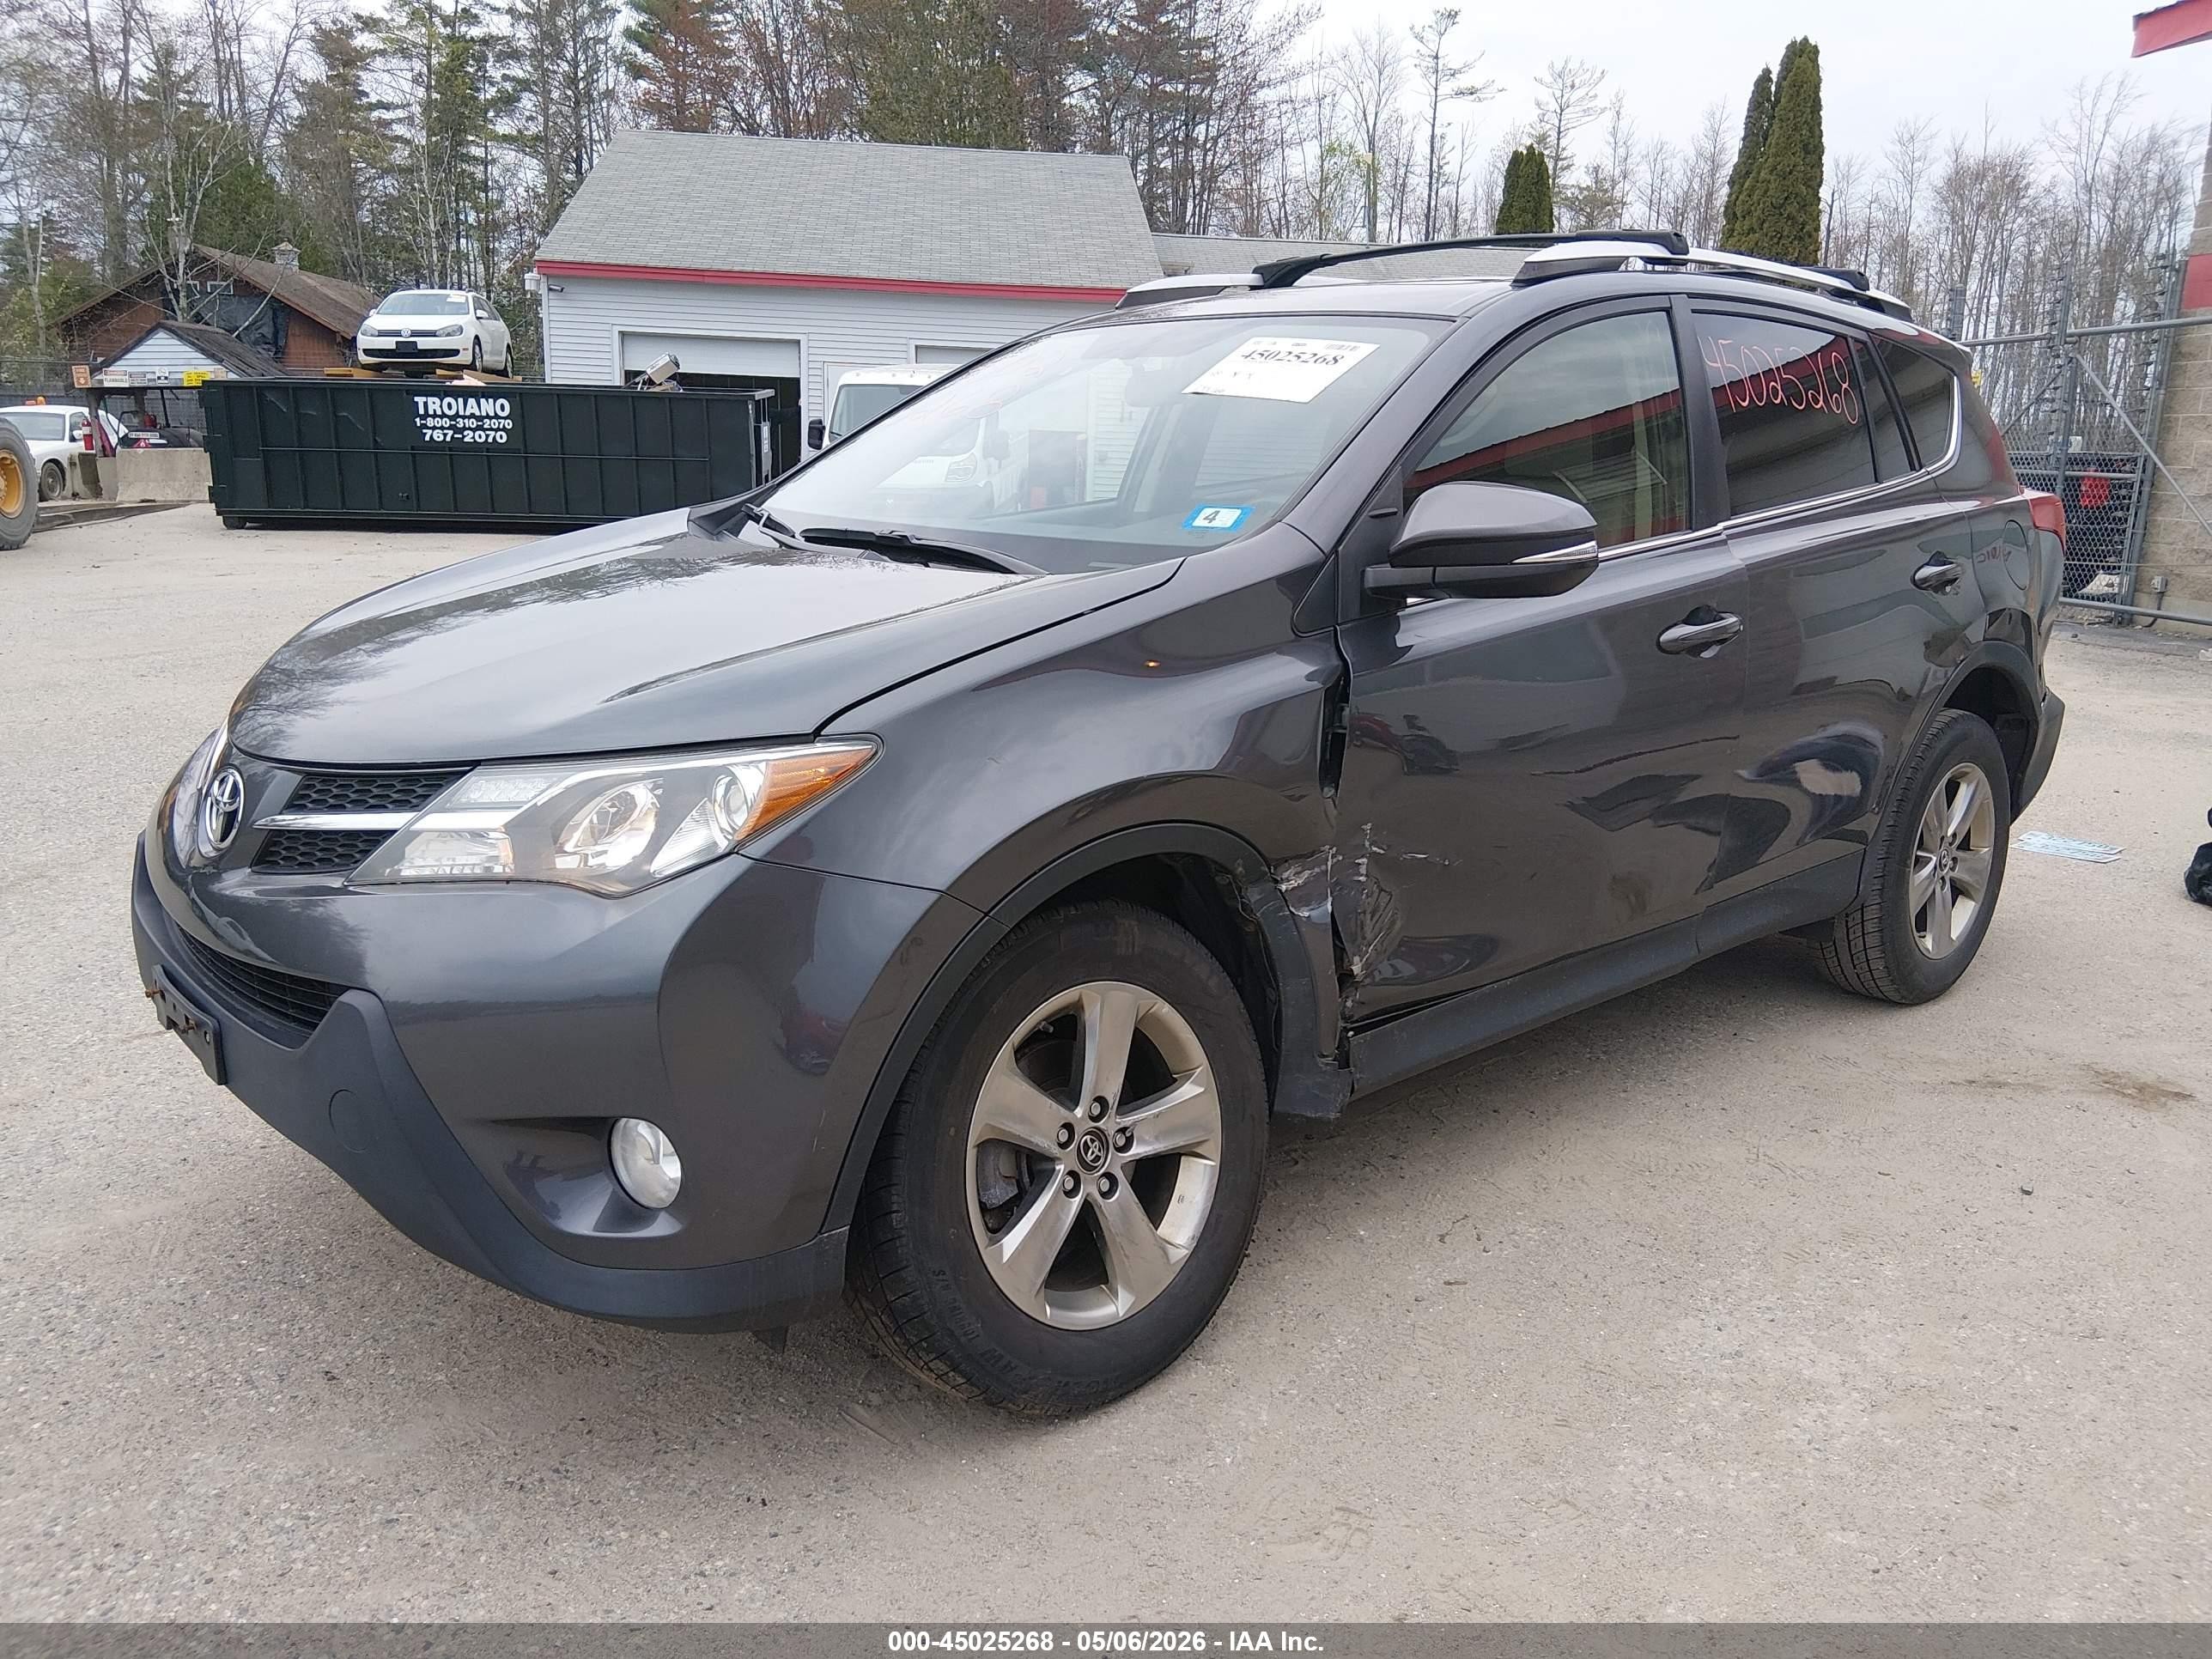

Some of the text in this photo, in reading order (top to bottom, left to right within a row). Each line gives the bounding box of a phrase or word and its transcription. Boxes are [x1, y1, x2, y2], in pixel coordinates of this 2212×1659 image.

[1241, 349, 1345, 366] 45025268
[1698, 336, 1858, 425] 45025268
[414, 397, 510, 417] TROIANO
[415, 417, 513, 429] 1-800-310-2070
[422, 429, 507, 443] 767-2070
[1203, 510, 1220, 524] 4
